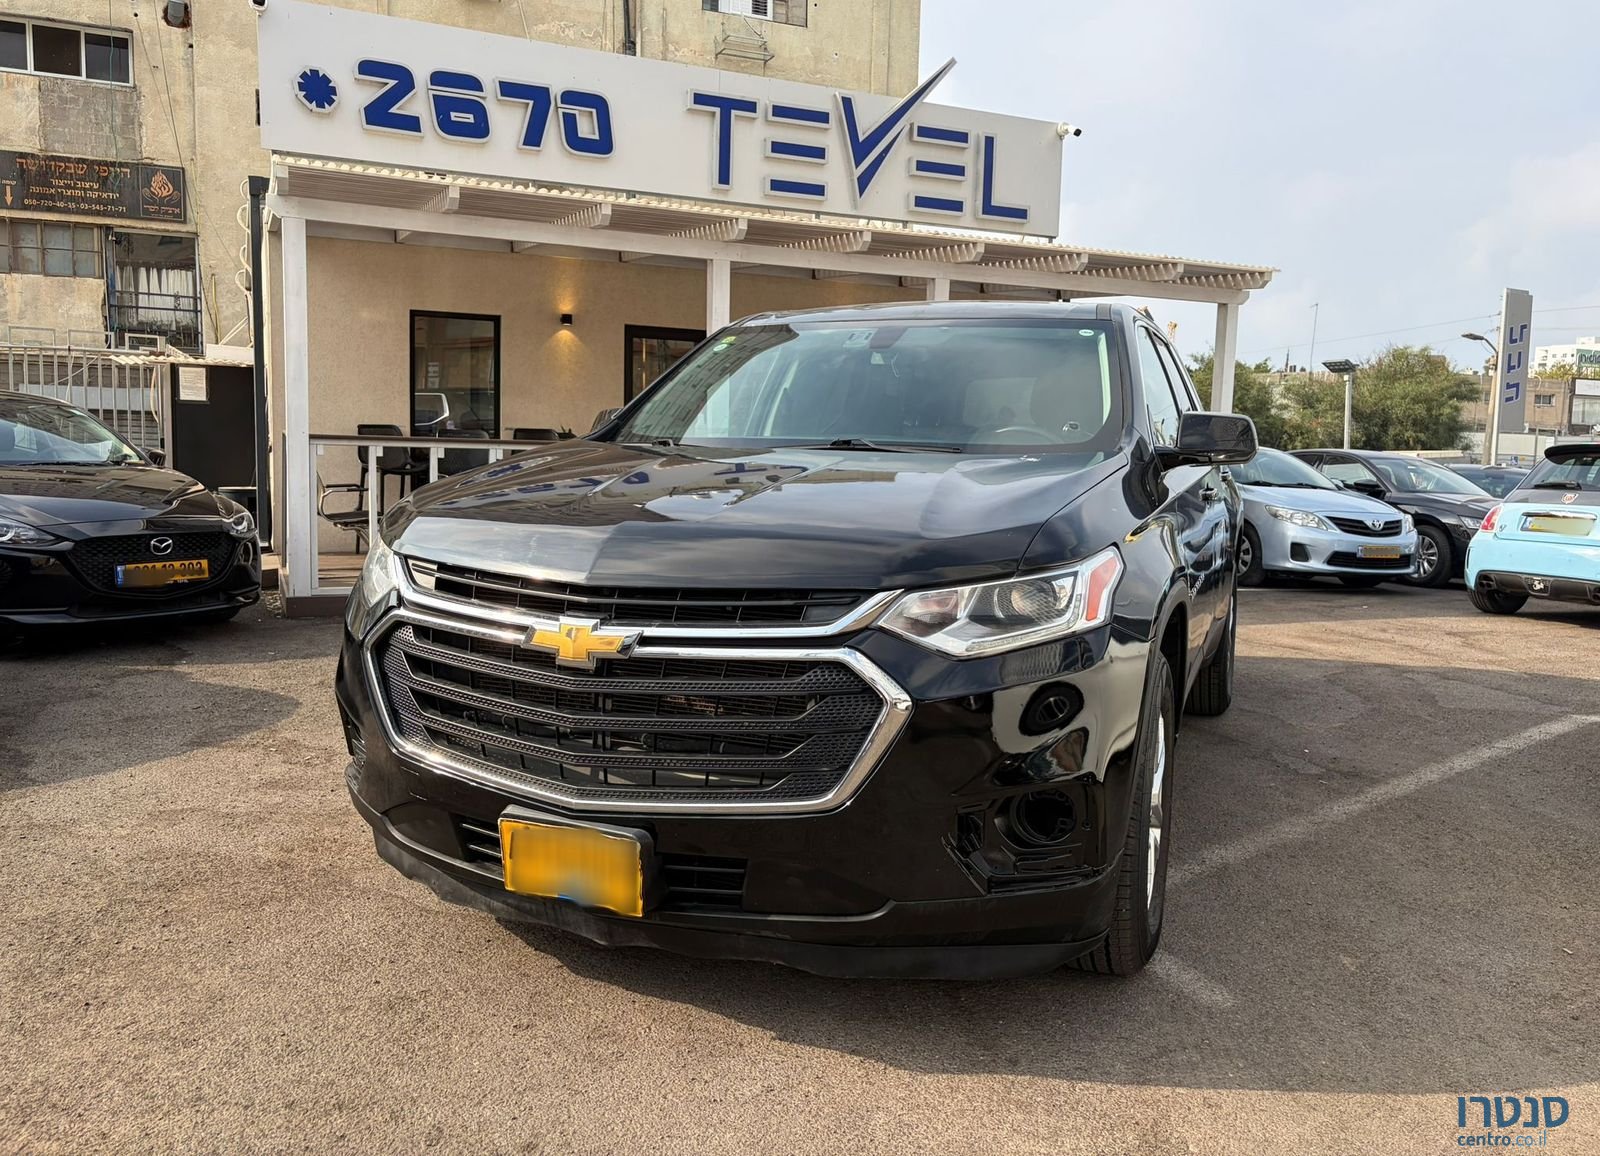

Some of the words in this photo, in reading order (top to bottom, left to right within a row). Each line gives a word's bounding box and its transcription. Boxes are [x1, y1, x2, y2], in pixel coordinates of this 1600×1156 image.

[688, 58, 1030, 222] TEVEL
[50, 178, 74, 187] וייצור
[76, 180, 99, 189] עיצוב
[29, 186, 56, 194] אמונה
[57, 188, 85, 197] ומוצרי
[87, 190, 120, 200] יודאיקה
